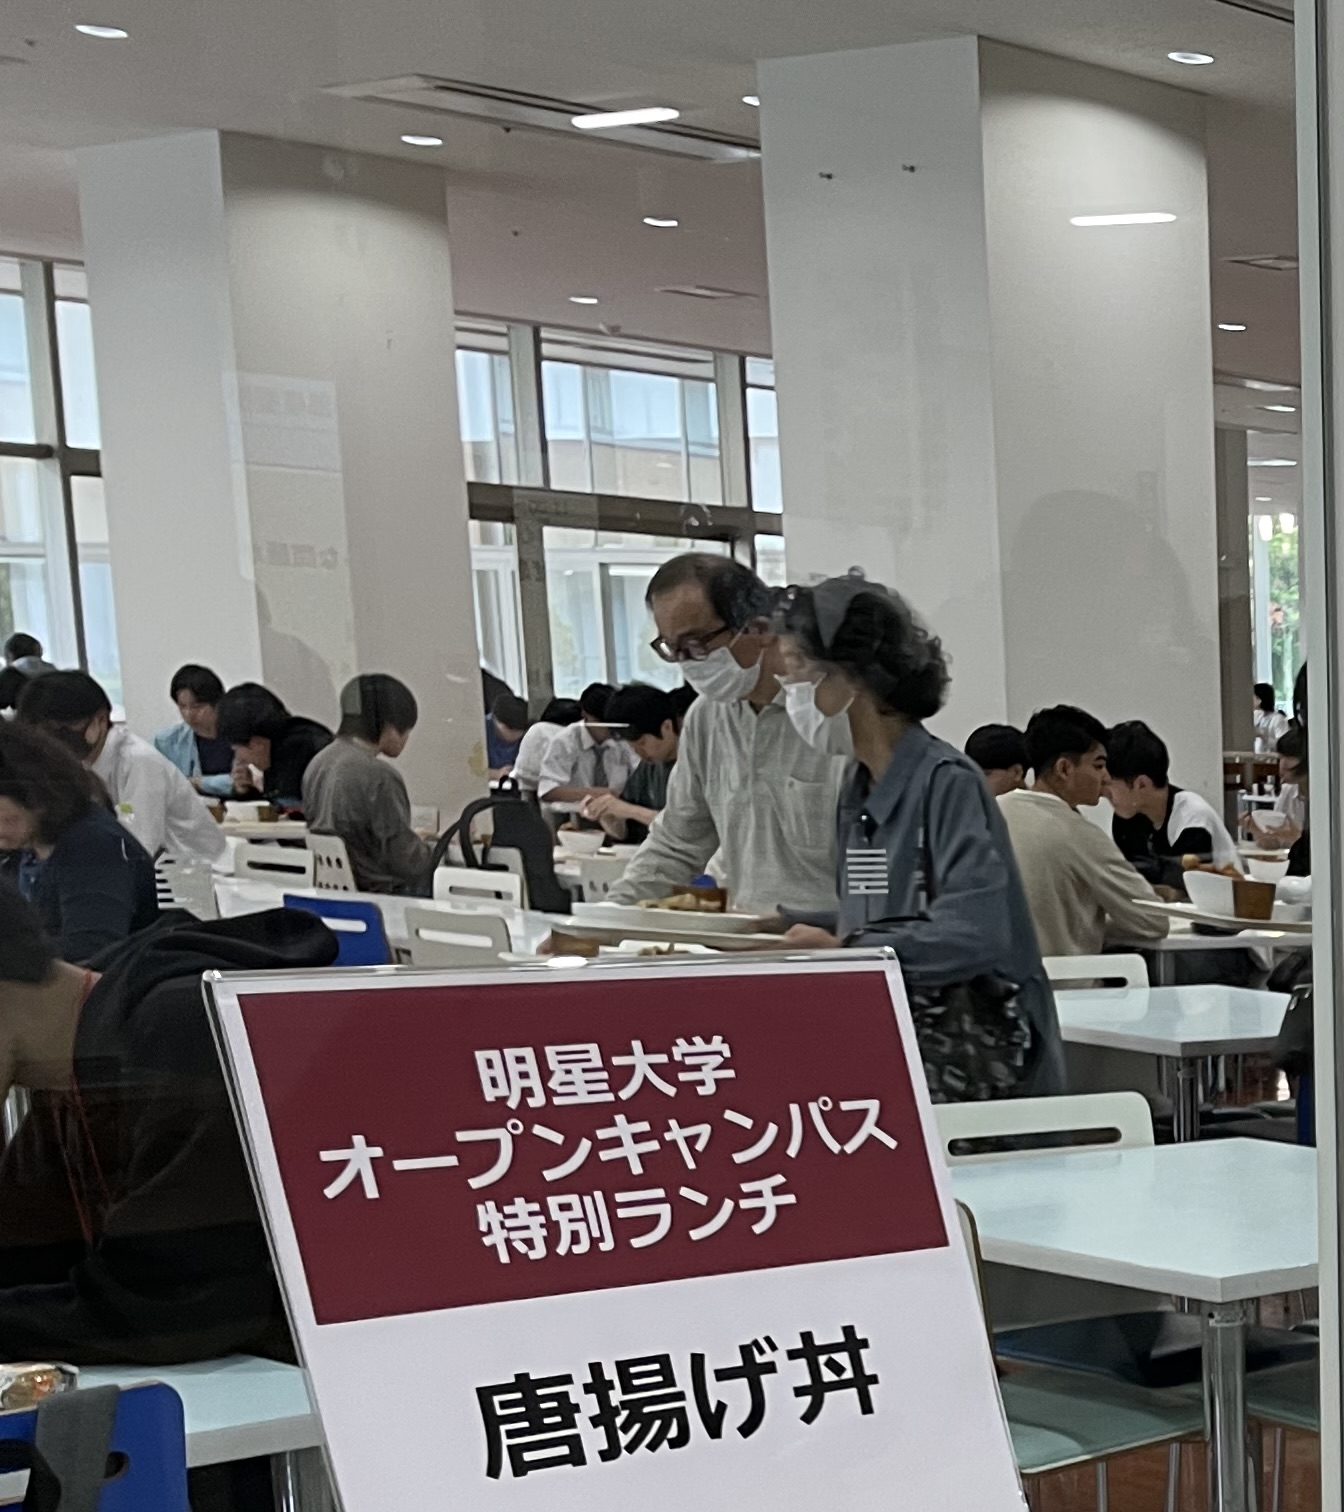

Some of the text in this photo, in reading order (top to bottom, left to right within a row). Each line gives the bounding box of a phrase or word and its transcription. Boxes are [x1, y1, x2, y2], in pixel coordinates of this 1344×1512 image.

[473, 1035, 737, 1111] 明星大学
[318, 1096, 899, 1201] オープンキャンパス
[476, 1173, 798, 1264] 特別ランチ
[474, 1324, 881, 1480] 唐揚げ丼
